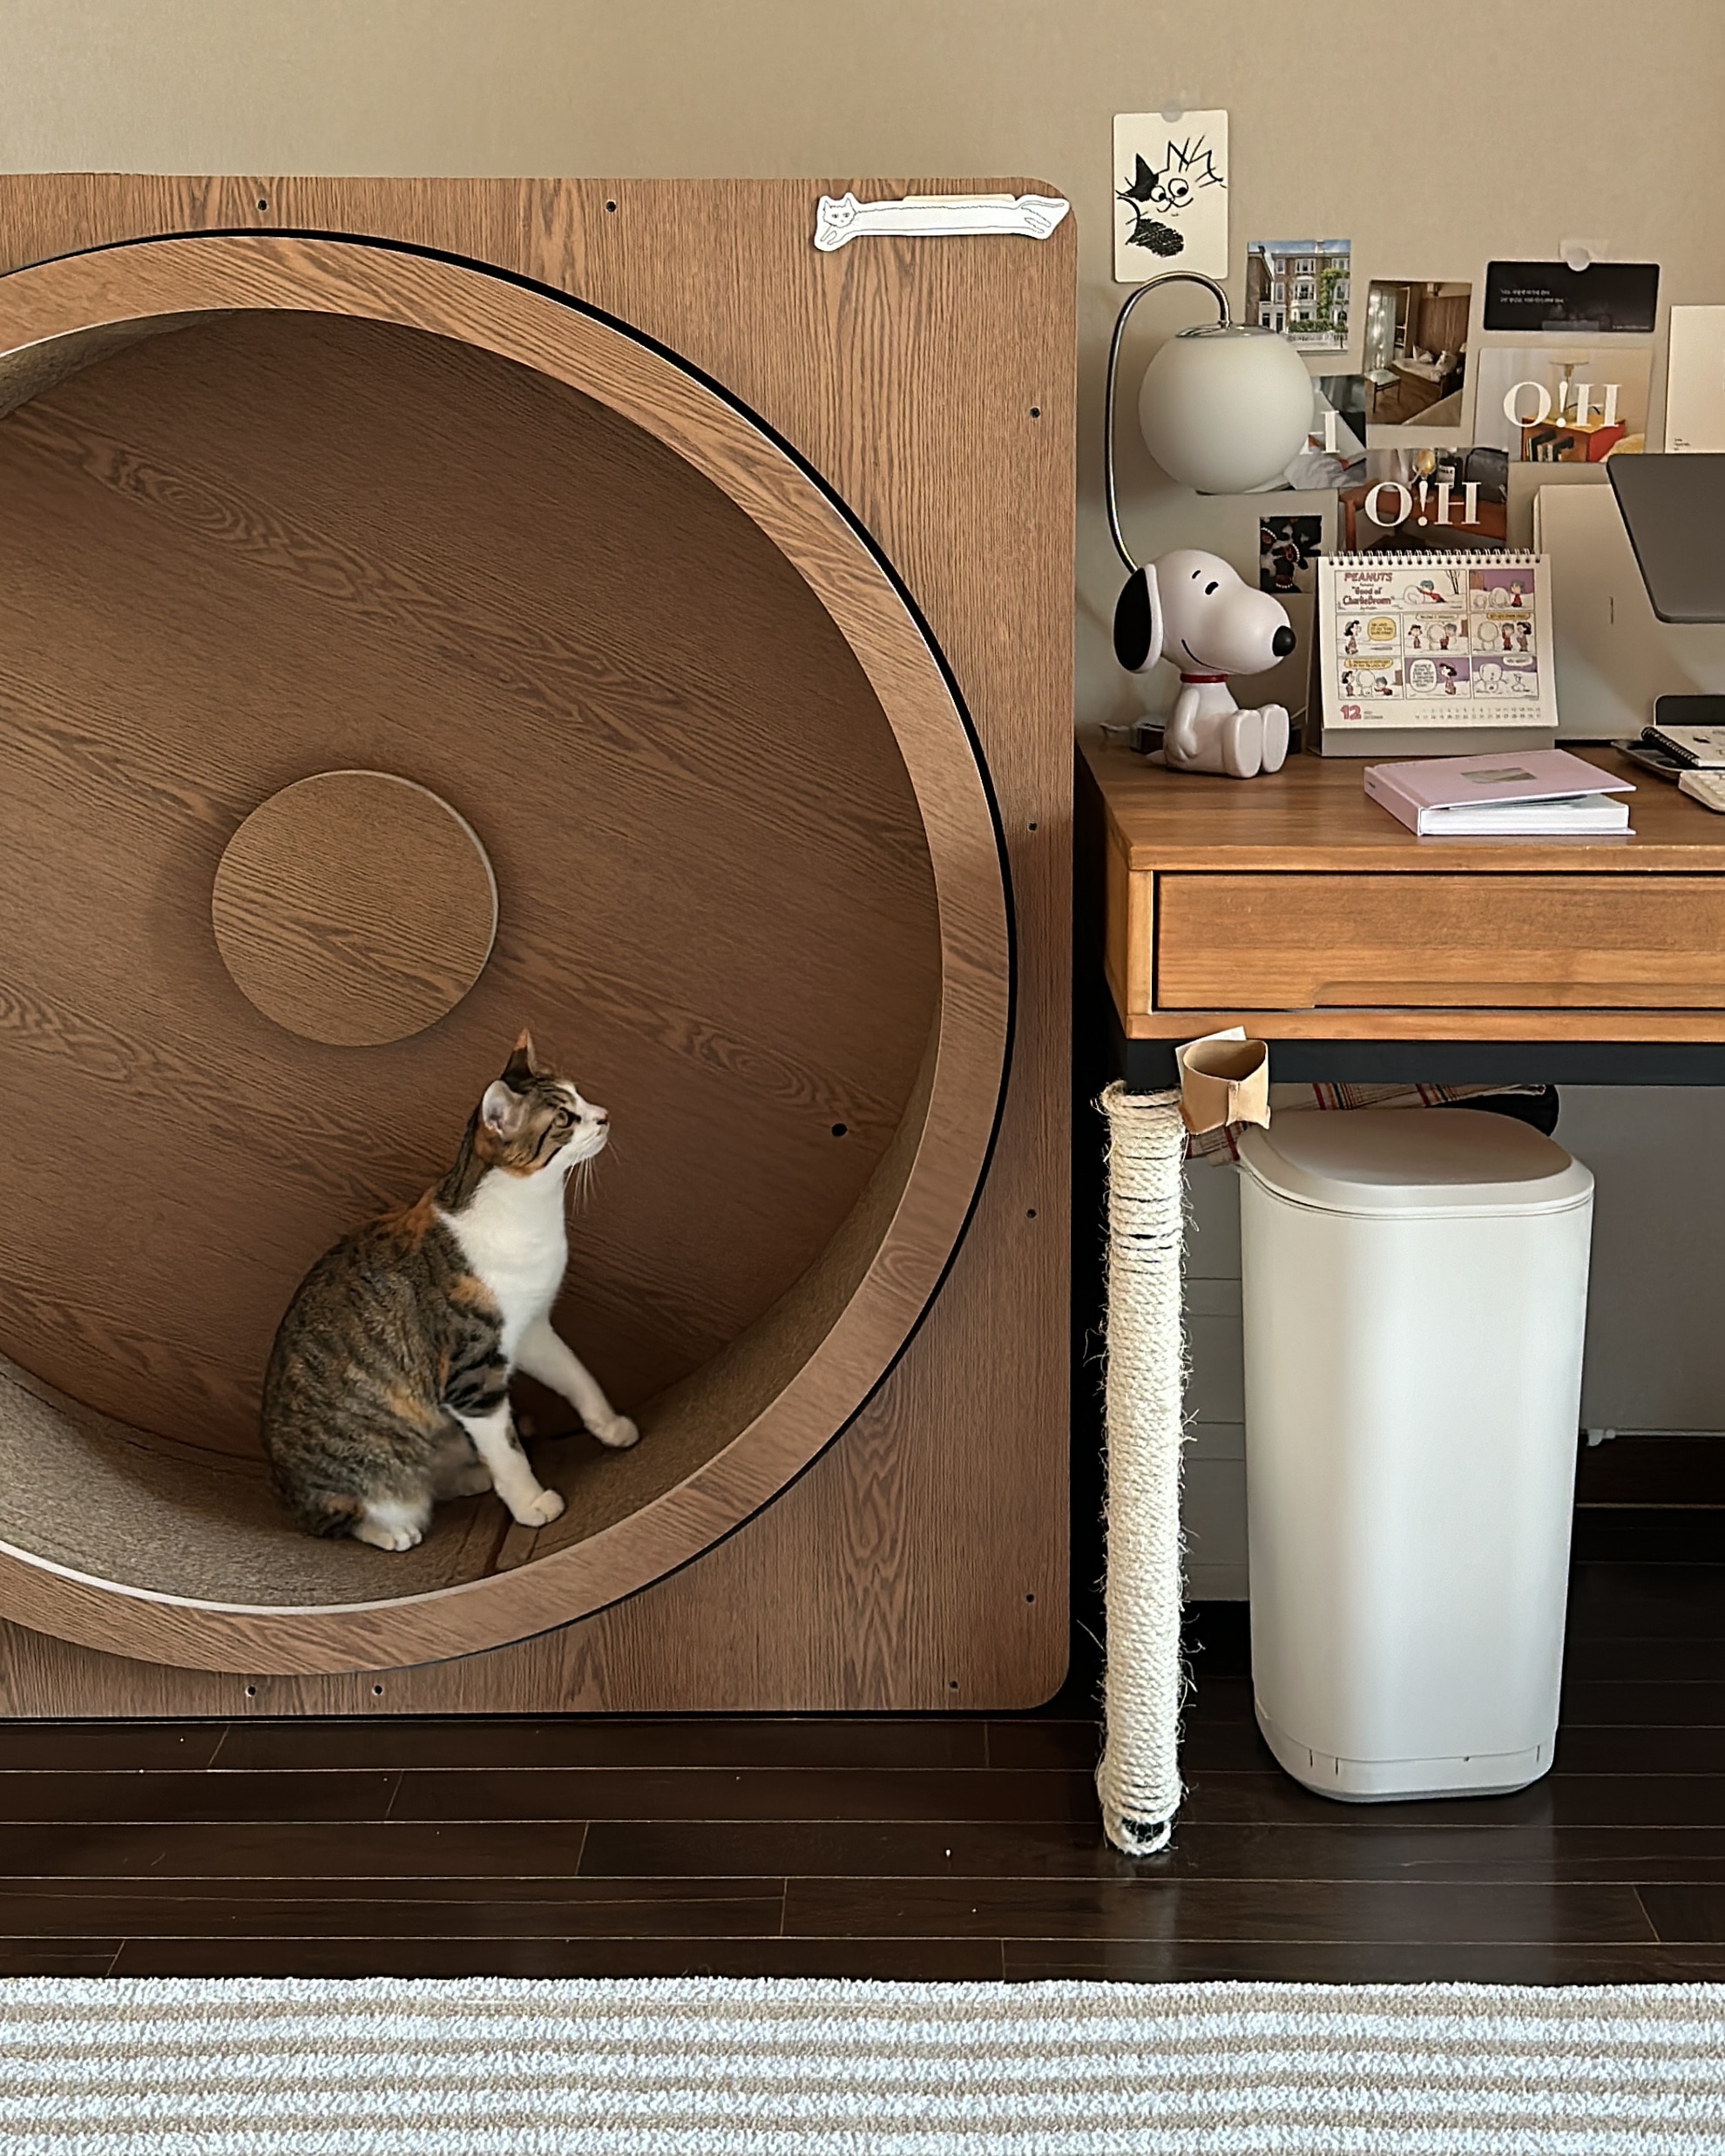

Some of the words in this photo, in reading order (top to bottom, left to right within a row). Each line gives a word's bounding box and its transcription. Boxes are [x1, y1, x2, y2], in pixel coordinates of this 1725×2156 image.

[1503, 381, 1622, 428] O!H
[1364, 480, 1482, 527] O!H
[1344, 572, 1393, 583] PEANUTS
[1340, 705, 1362, 720] 12
